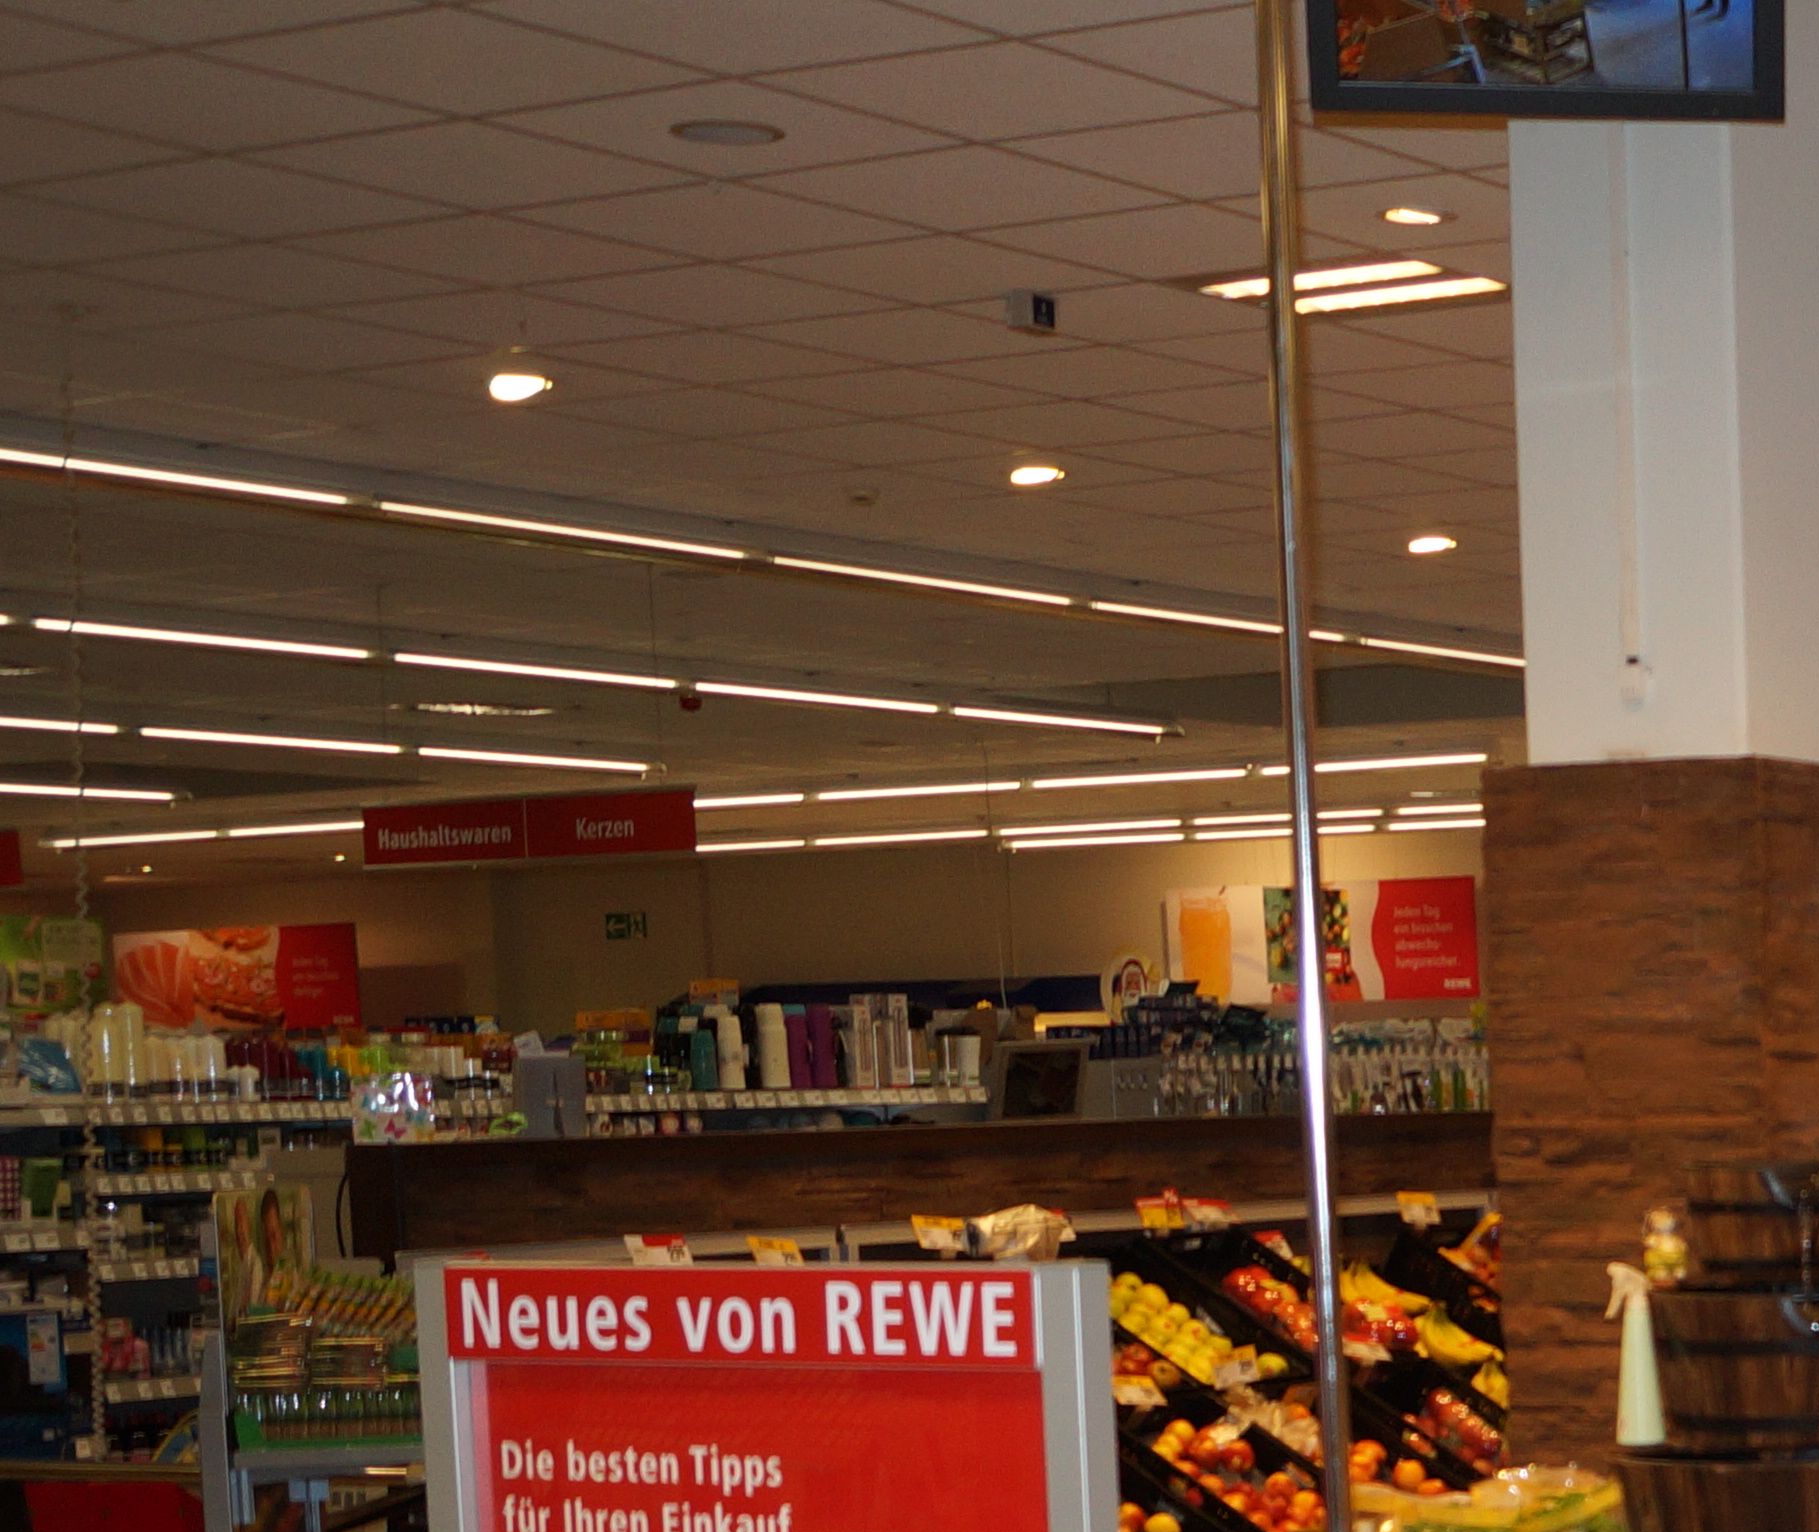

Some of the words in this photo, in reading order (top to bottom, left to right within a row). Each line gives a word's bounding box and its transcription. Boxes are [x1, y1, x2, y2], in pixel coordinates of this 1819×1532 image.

[378, 825, 513, 851] Haushaltswaren
[576, 817, 635, 840] Kerzen
[461, 1278, 652, 1352] Neues
[677, 1296, 796, 1354] von
[825, 1280, 1018, 1357] REWE
[501, 1440, 553, 1481] Die
[567, 1443, 679, 1486] besten
[689, 1445, 782, 1497] Tipps
